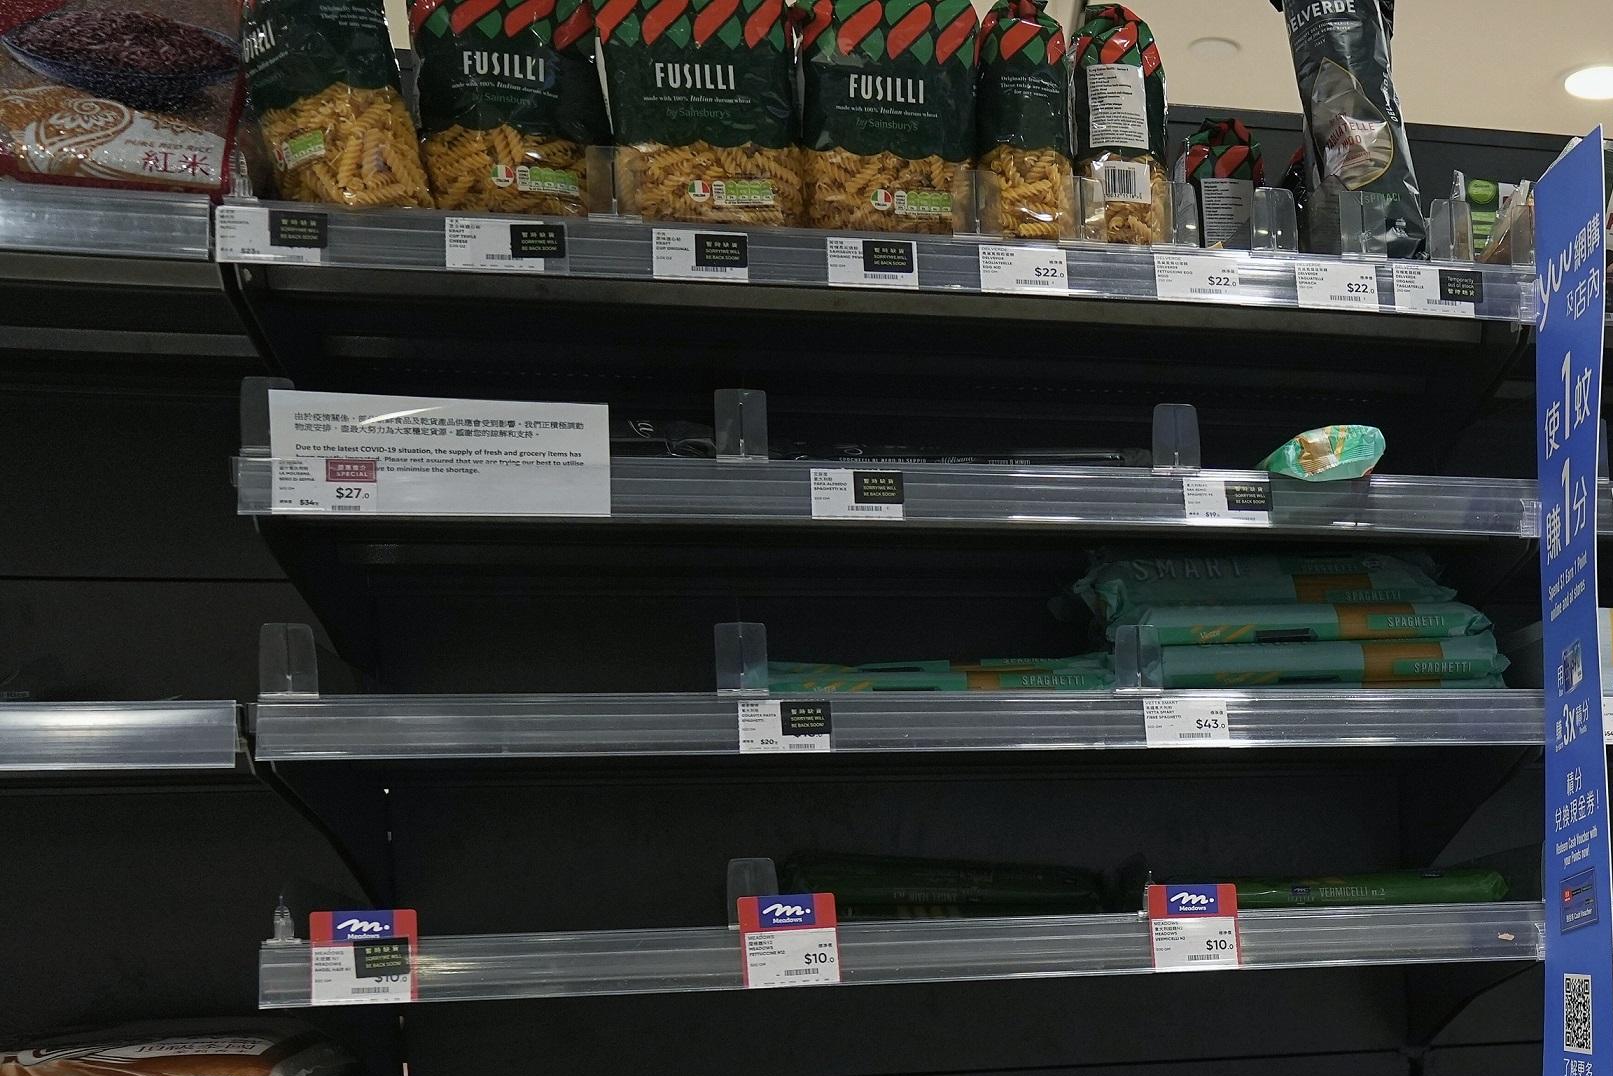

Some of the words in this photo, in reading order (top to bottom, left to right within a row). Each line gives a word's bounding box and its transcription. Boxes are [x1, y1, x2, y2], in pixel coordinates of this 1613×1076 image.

[463, 50, 545, 82] FUSILLI
[655, 62, 735, 90] FUSILLI
[849, 74, 924, 104] FUSILLI
[143, 150, 209, 176] 紅米
[1034, 266, 1065, 280] $22.0
[1540, 241, 1572, 332] yuu
[1574, 212, 1600, 272] 網購
[1567, 267, 1600, 320] 及店內
[1545, 350, 1592, 460] 使1蚊
[336, 488, 369, 499] $27.0
[1546, 457, 1587, 566] 賺1分
[1567, 766, 1582, 796] 積分
[1319, 886, 1369, 898] VERMICELLI
[1178, 905, 1207, 913] Meadows
[1206, 938, 1234, 951] $10.0
